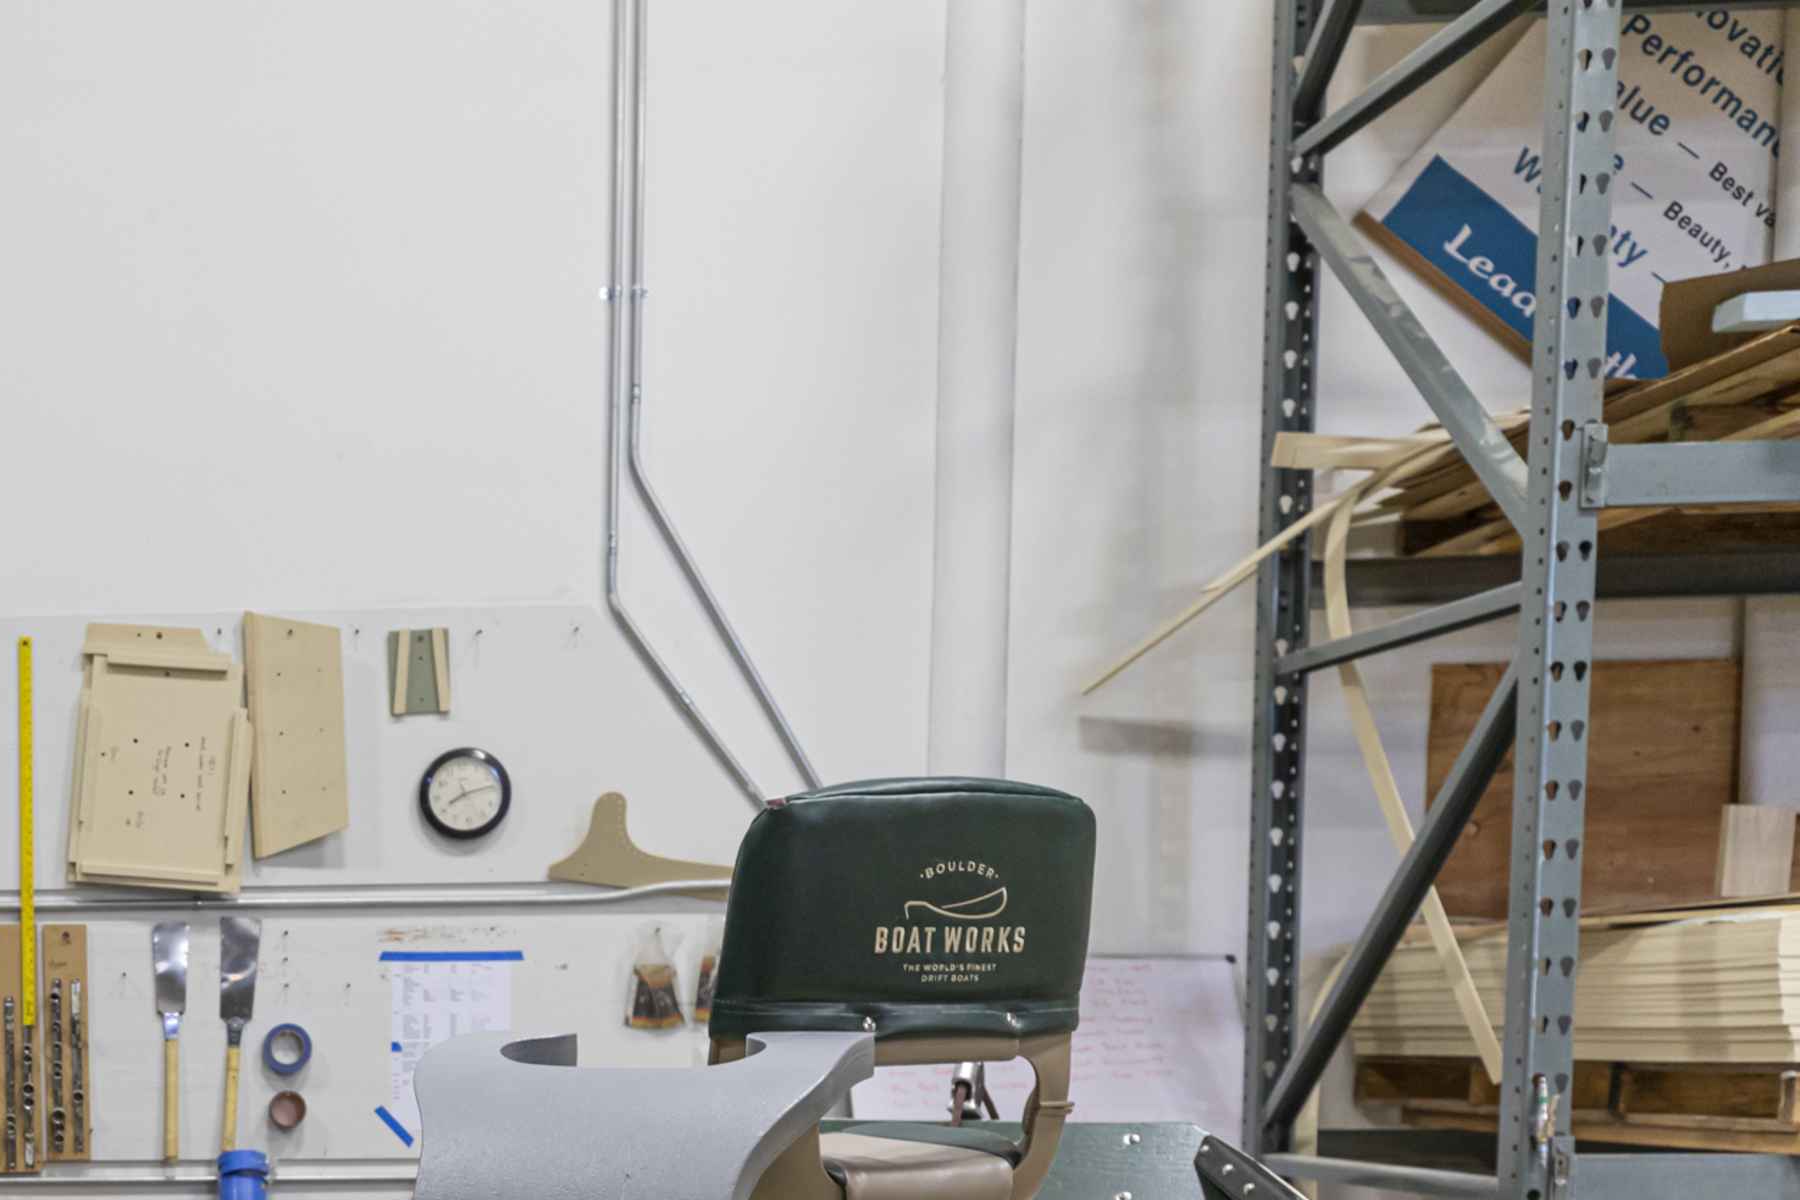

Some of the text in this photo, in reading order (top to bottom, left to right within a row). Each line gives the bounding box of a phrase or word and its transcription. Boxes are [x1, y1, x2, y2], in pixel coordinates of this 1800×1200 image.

[1696, 9, 1784, 86] ovati
[1708, 162, 1754, 207] Best
[1663, 201, 1731, 270] Beauty,
[924, 861, 996, 880] BOULDER
[875, 926, 1026, 953] BOAT WORKS
[903, 963, 920, 972] THE
[921, 974, 980, 983] DRIFT BOATS
